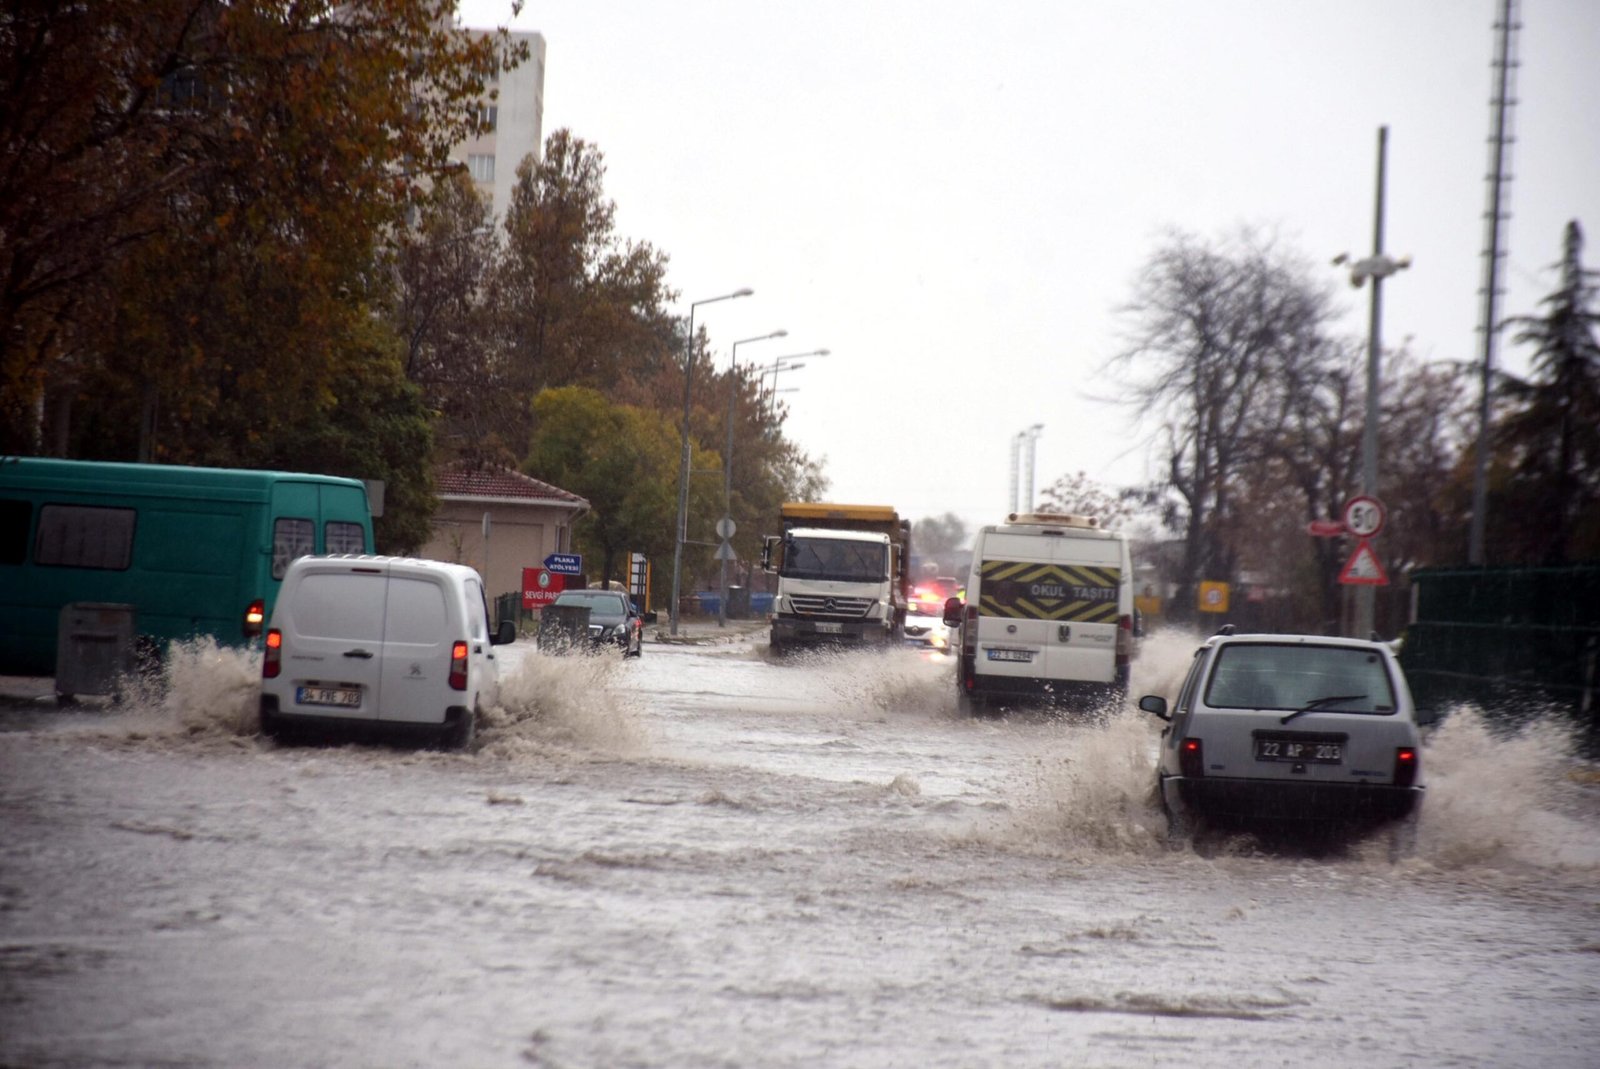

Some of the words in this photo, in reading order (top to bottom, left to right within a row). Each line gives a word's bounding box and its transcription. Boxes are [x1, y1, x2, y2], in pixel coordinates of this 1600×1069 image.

[1353, 506, 1376, 529] 50
[554, 556, 575, 564] PLAKA
[1031, 584, 1066, 597] OKUL
[1263, 742, 1280, 757] 22
[1286, 743, 1304, 757] AP
[1316, 745, 1341, 759] 203
